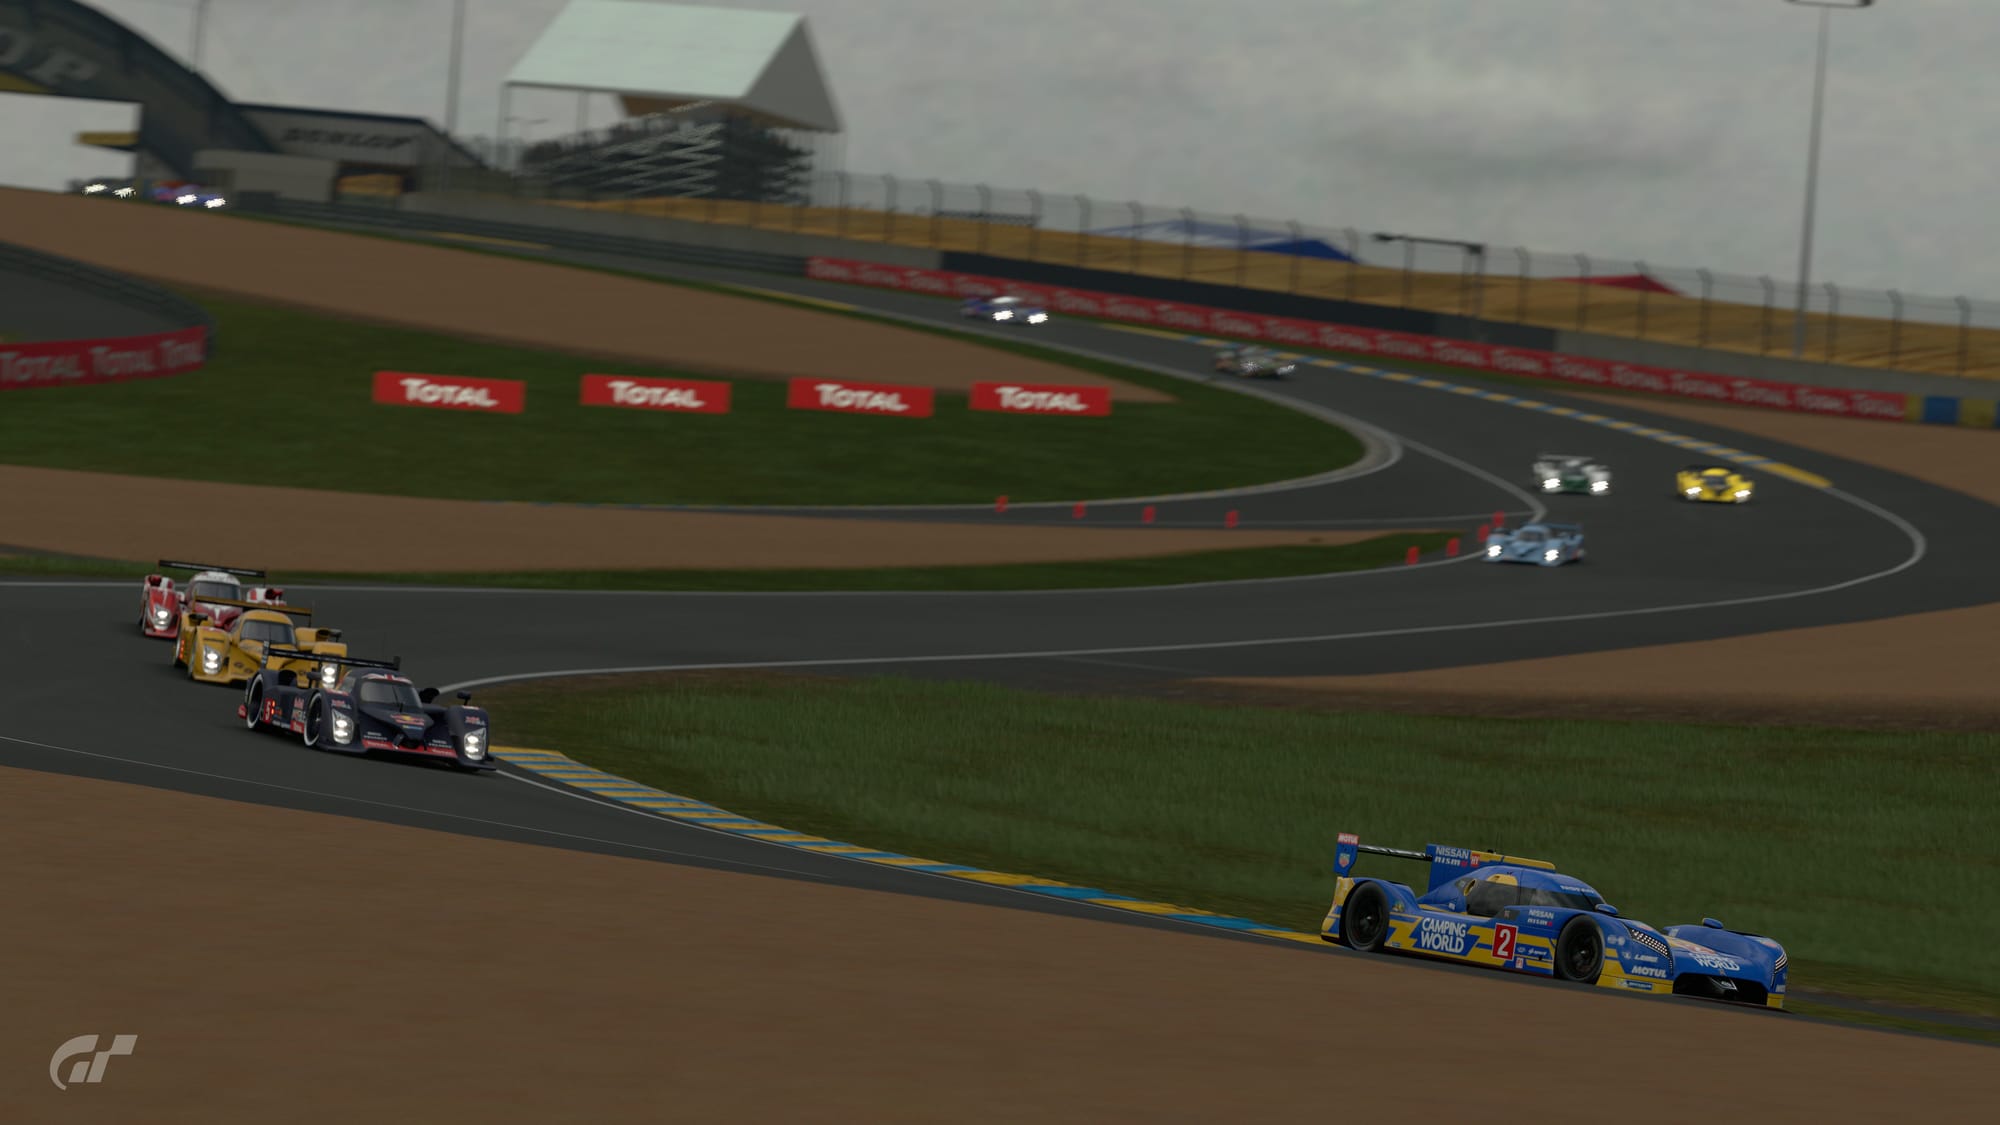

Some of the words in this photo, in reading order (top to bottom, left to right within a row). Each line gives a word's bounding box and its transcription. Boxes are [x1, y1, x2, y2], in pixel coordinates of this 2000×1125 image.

[400, 378, 499, 407] TOTAL
[607, 380, 706, 408] TOTAL
[815, 383, 910, 411] TOTAL
[995, 386, 1088, 412] TOTAL
[1434, 846, 1469, 860] NISSAN
[1528, 909, 1554, 919] NISSAN
[1422, 917, 1466, 938] CAMPING
[1420, 931, 1465, 954] WORLD
[1496, 928, 1511, 957] 2
[1631, 965, 1667, 979] MOTUL
